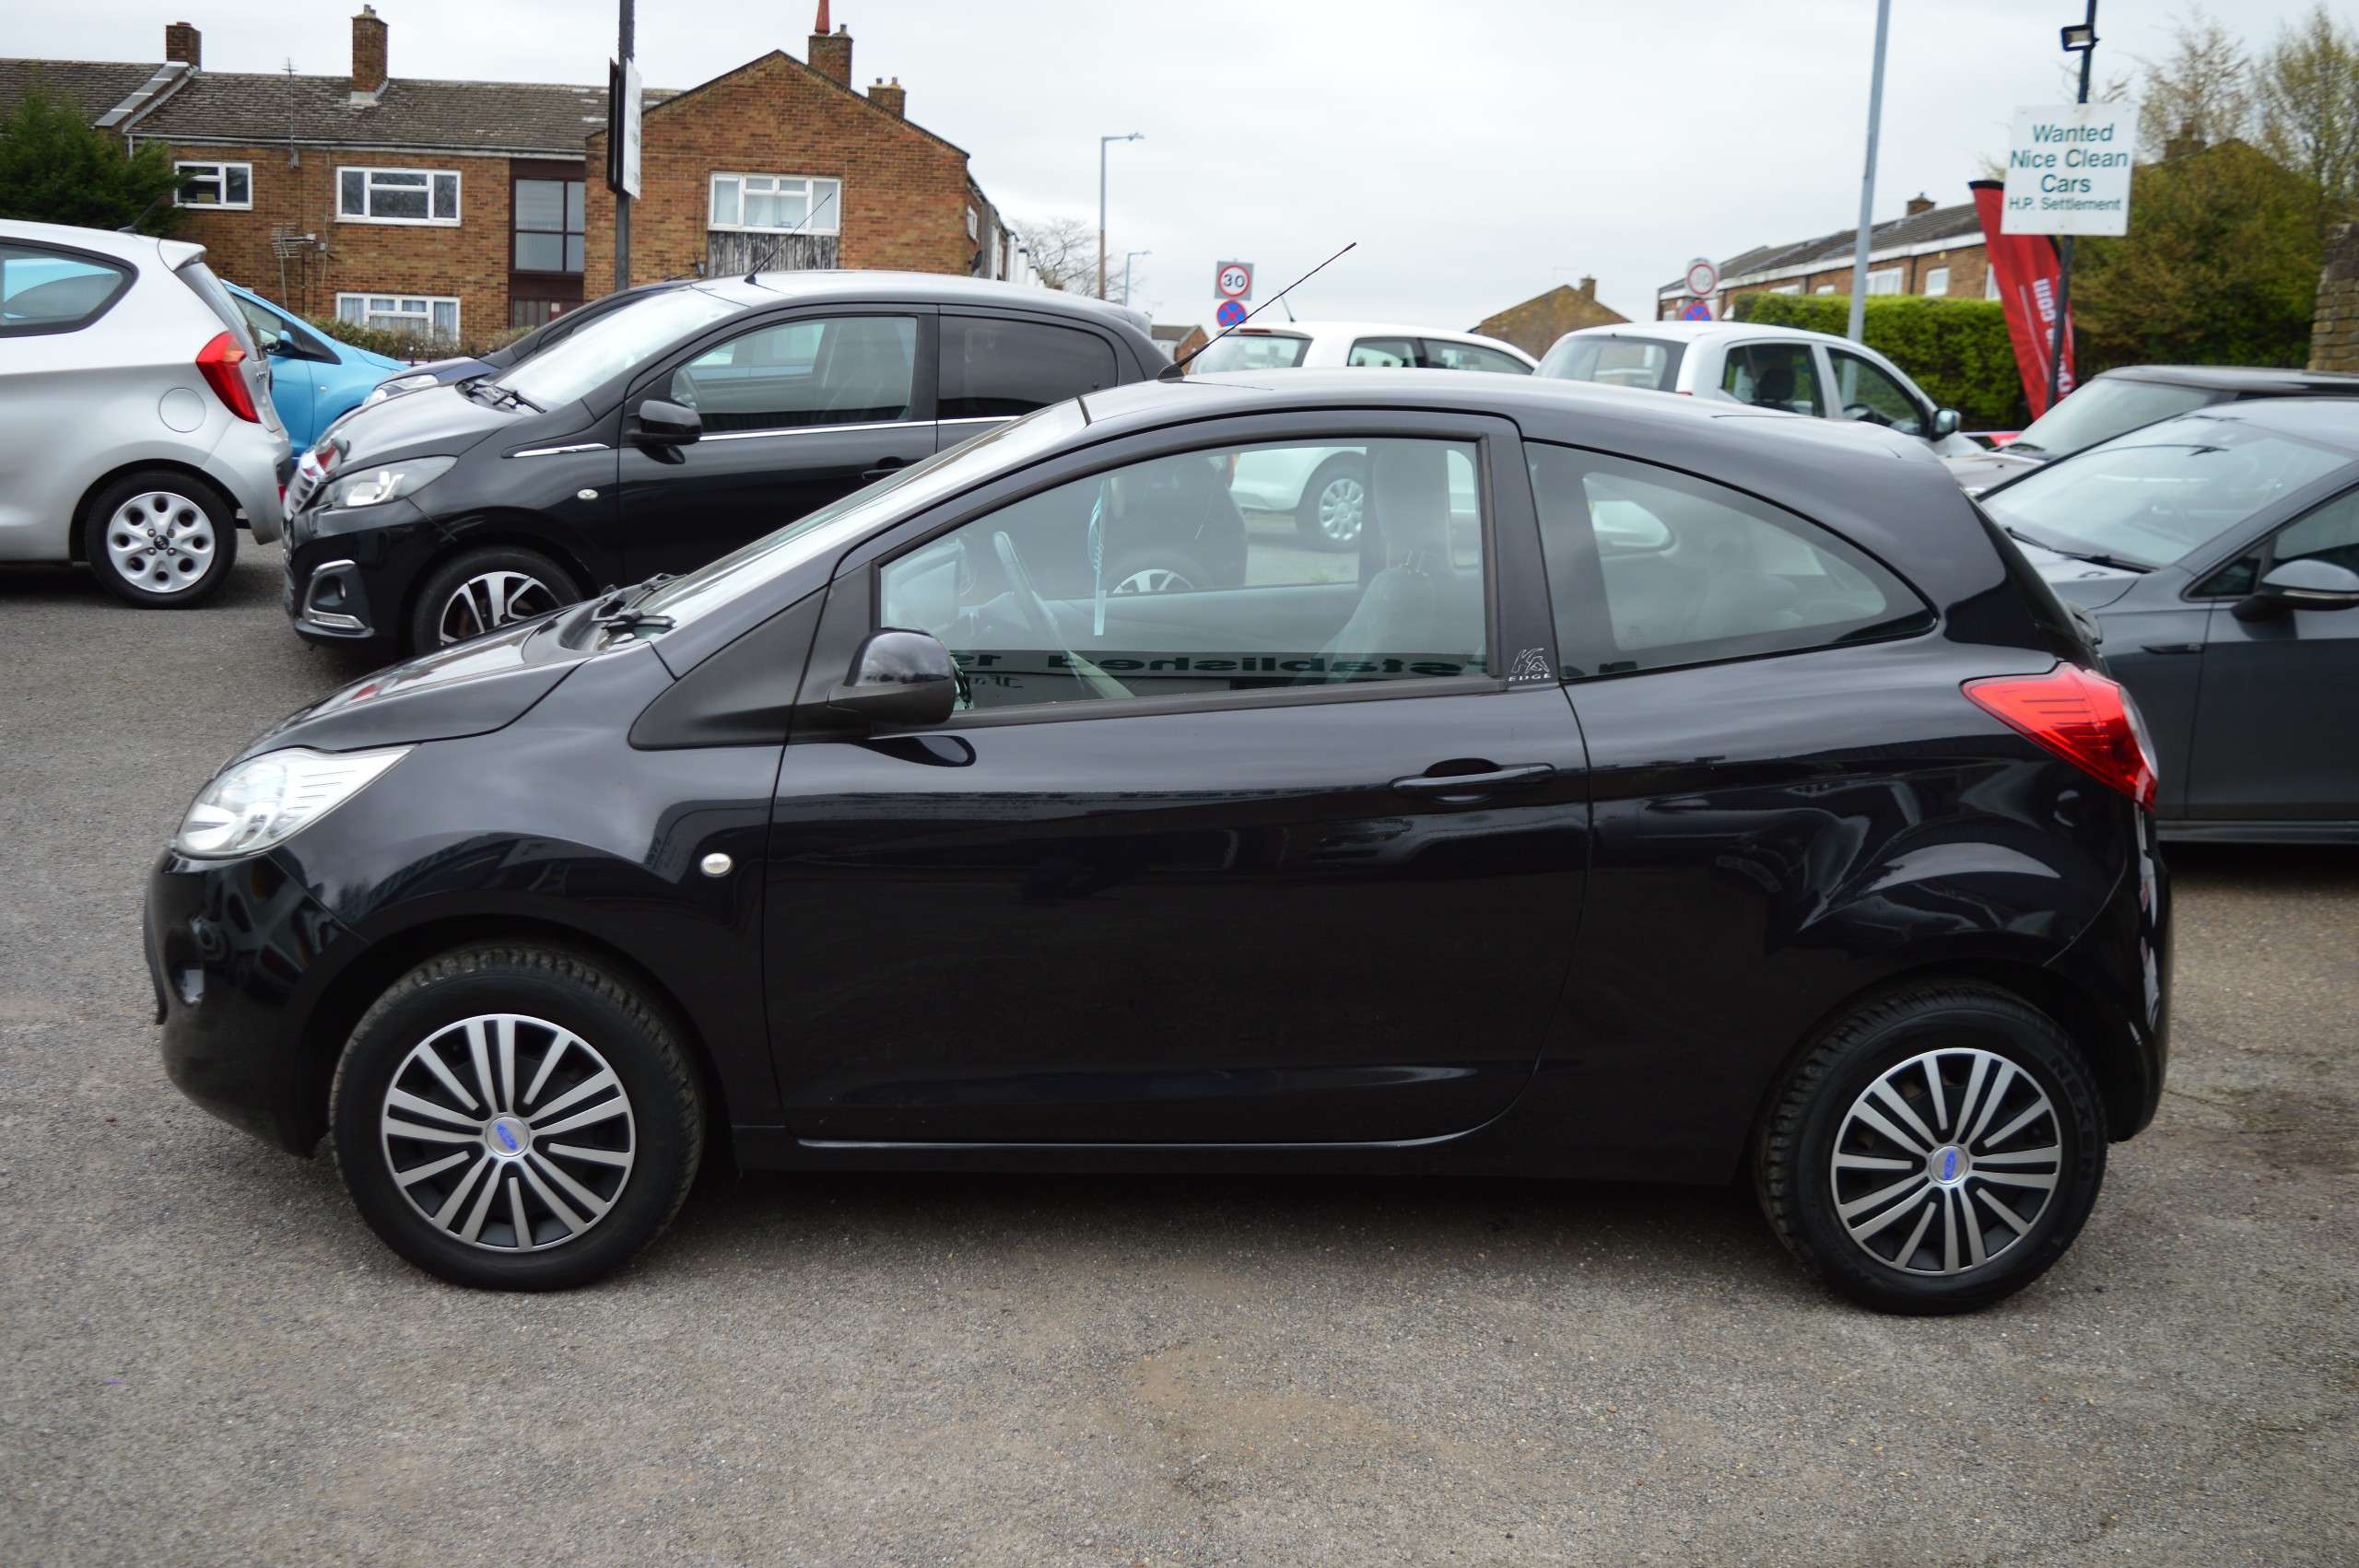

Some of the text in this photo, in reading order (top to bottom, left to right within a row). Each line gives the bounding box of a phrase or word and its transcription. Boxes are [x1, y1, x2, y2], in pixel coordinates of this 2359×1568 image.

[2033, 123, 2114, 143] Wanted
[2010, 148, 2128, 169] Nice Clean
[2041, 174, 2091, 193] Cars
[2040, 196, 2122, 211] Settlement
[1224, 274, 1245, 287] 30
